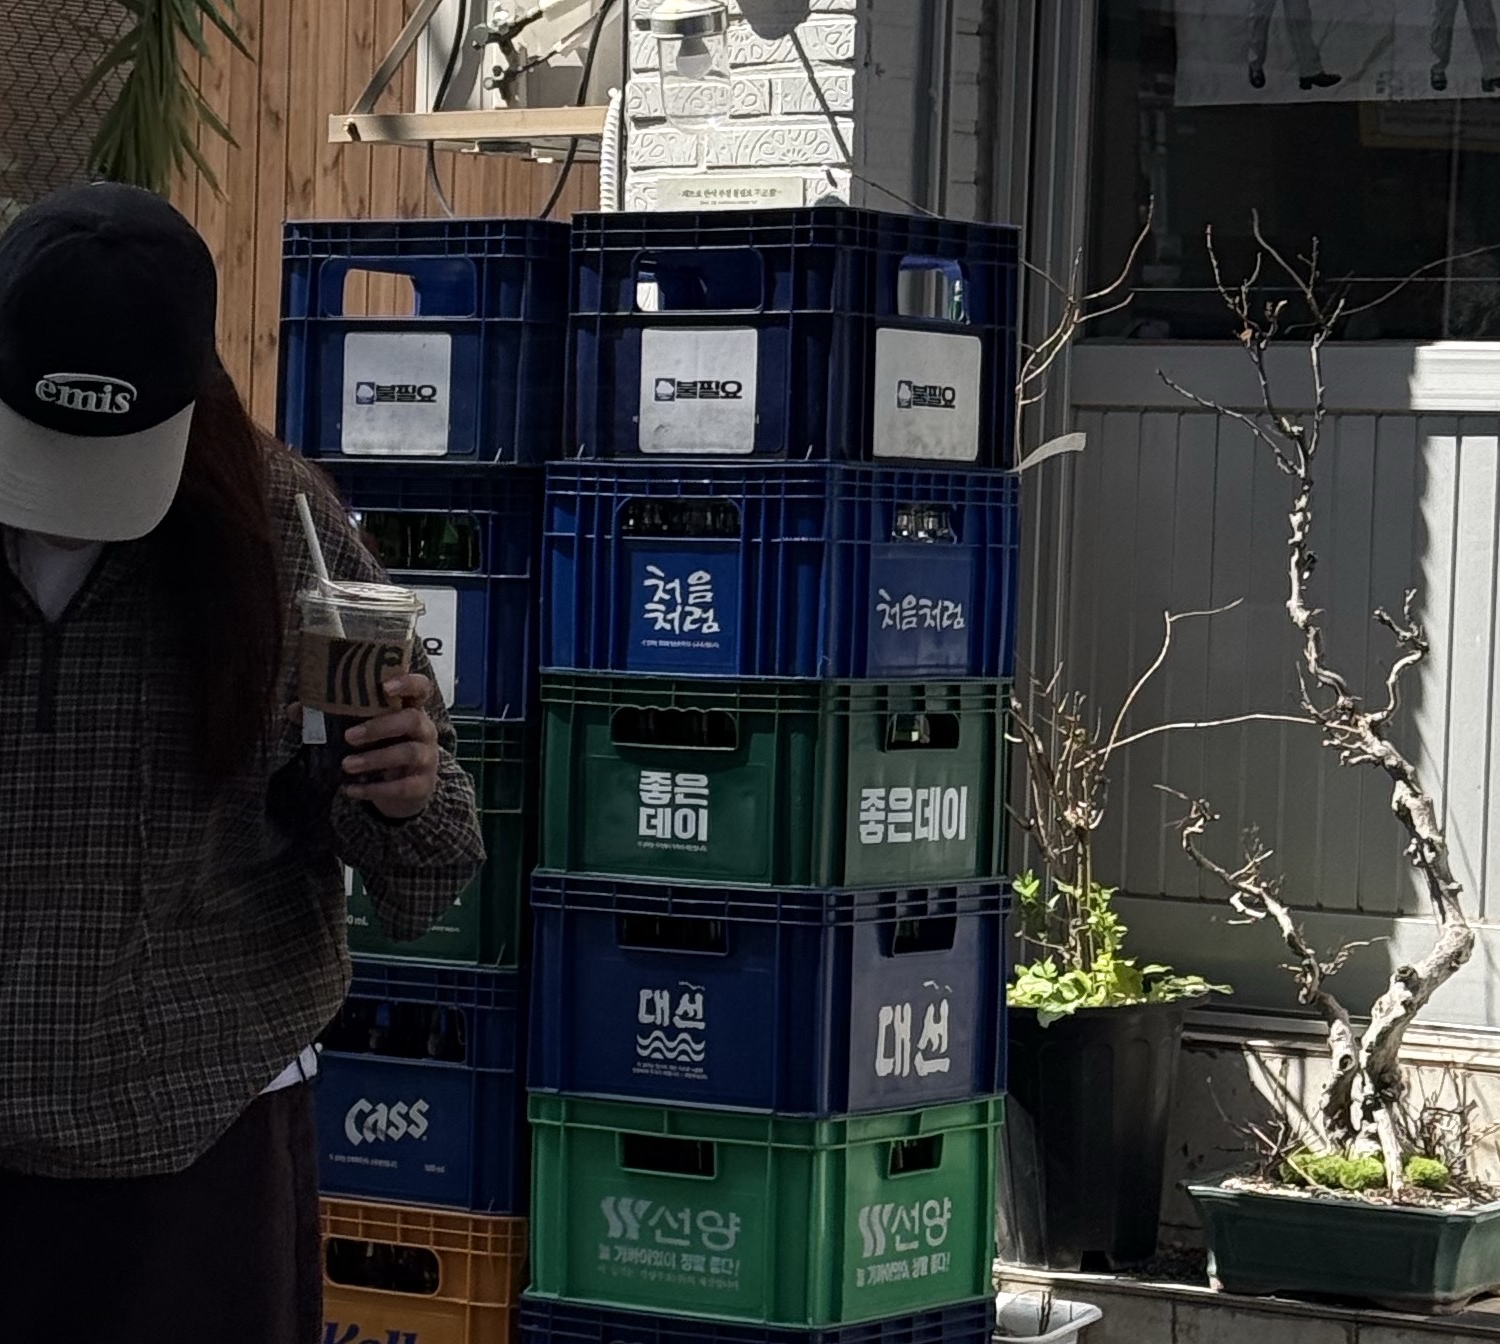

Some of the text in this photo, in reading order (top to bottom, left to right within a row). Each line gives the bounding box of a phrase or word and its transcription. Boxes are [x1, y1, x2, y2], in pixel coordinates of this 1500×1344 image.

[35, 379, 131, 414] emis
[642, 565, 713, 605] 처음
[642, 602, 721, 635] 처럼
[875, 588, 966, 632] 처음처럼
[638, 769, 710, 807] 좋은
[637, 807, 709, 843] 데이
[858, 784, 968, 845] 좋은데이
[637, 988, 706, 1031] 대선
[874, 998, 950, 1078] 대선
[344, 1097, 431, 1147] Cass
[647, 1205, 741, 1251] 선양
[889, 1196, 952, 1253] 선양
